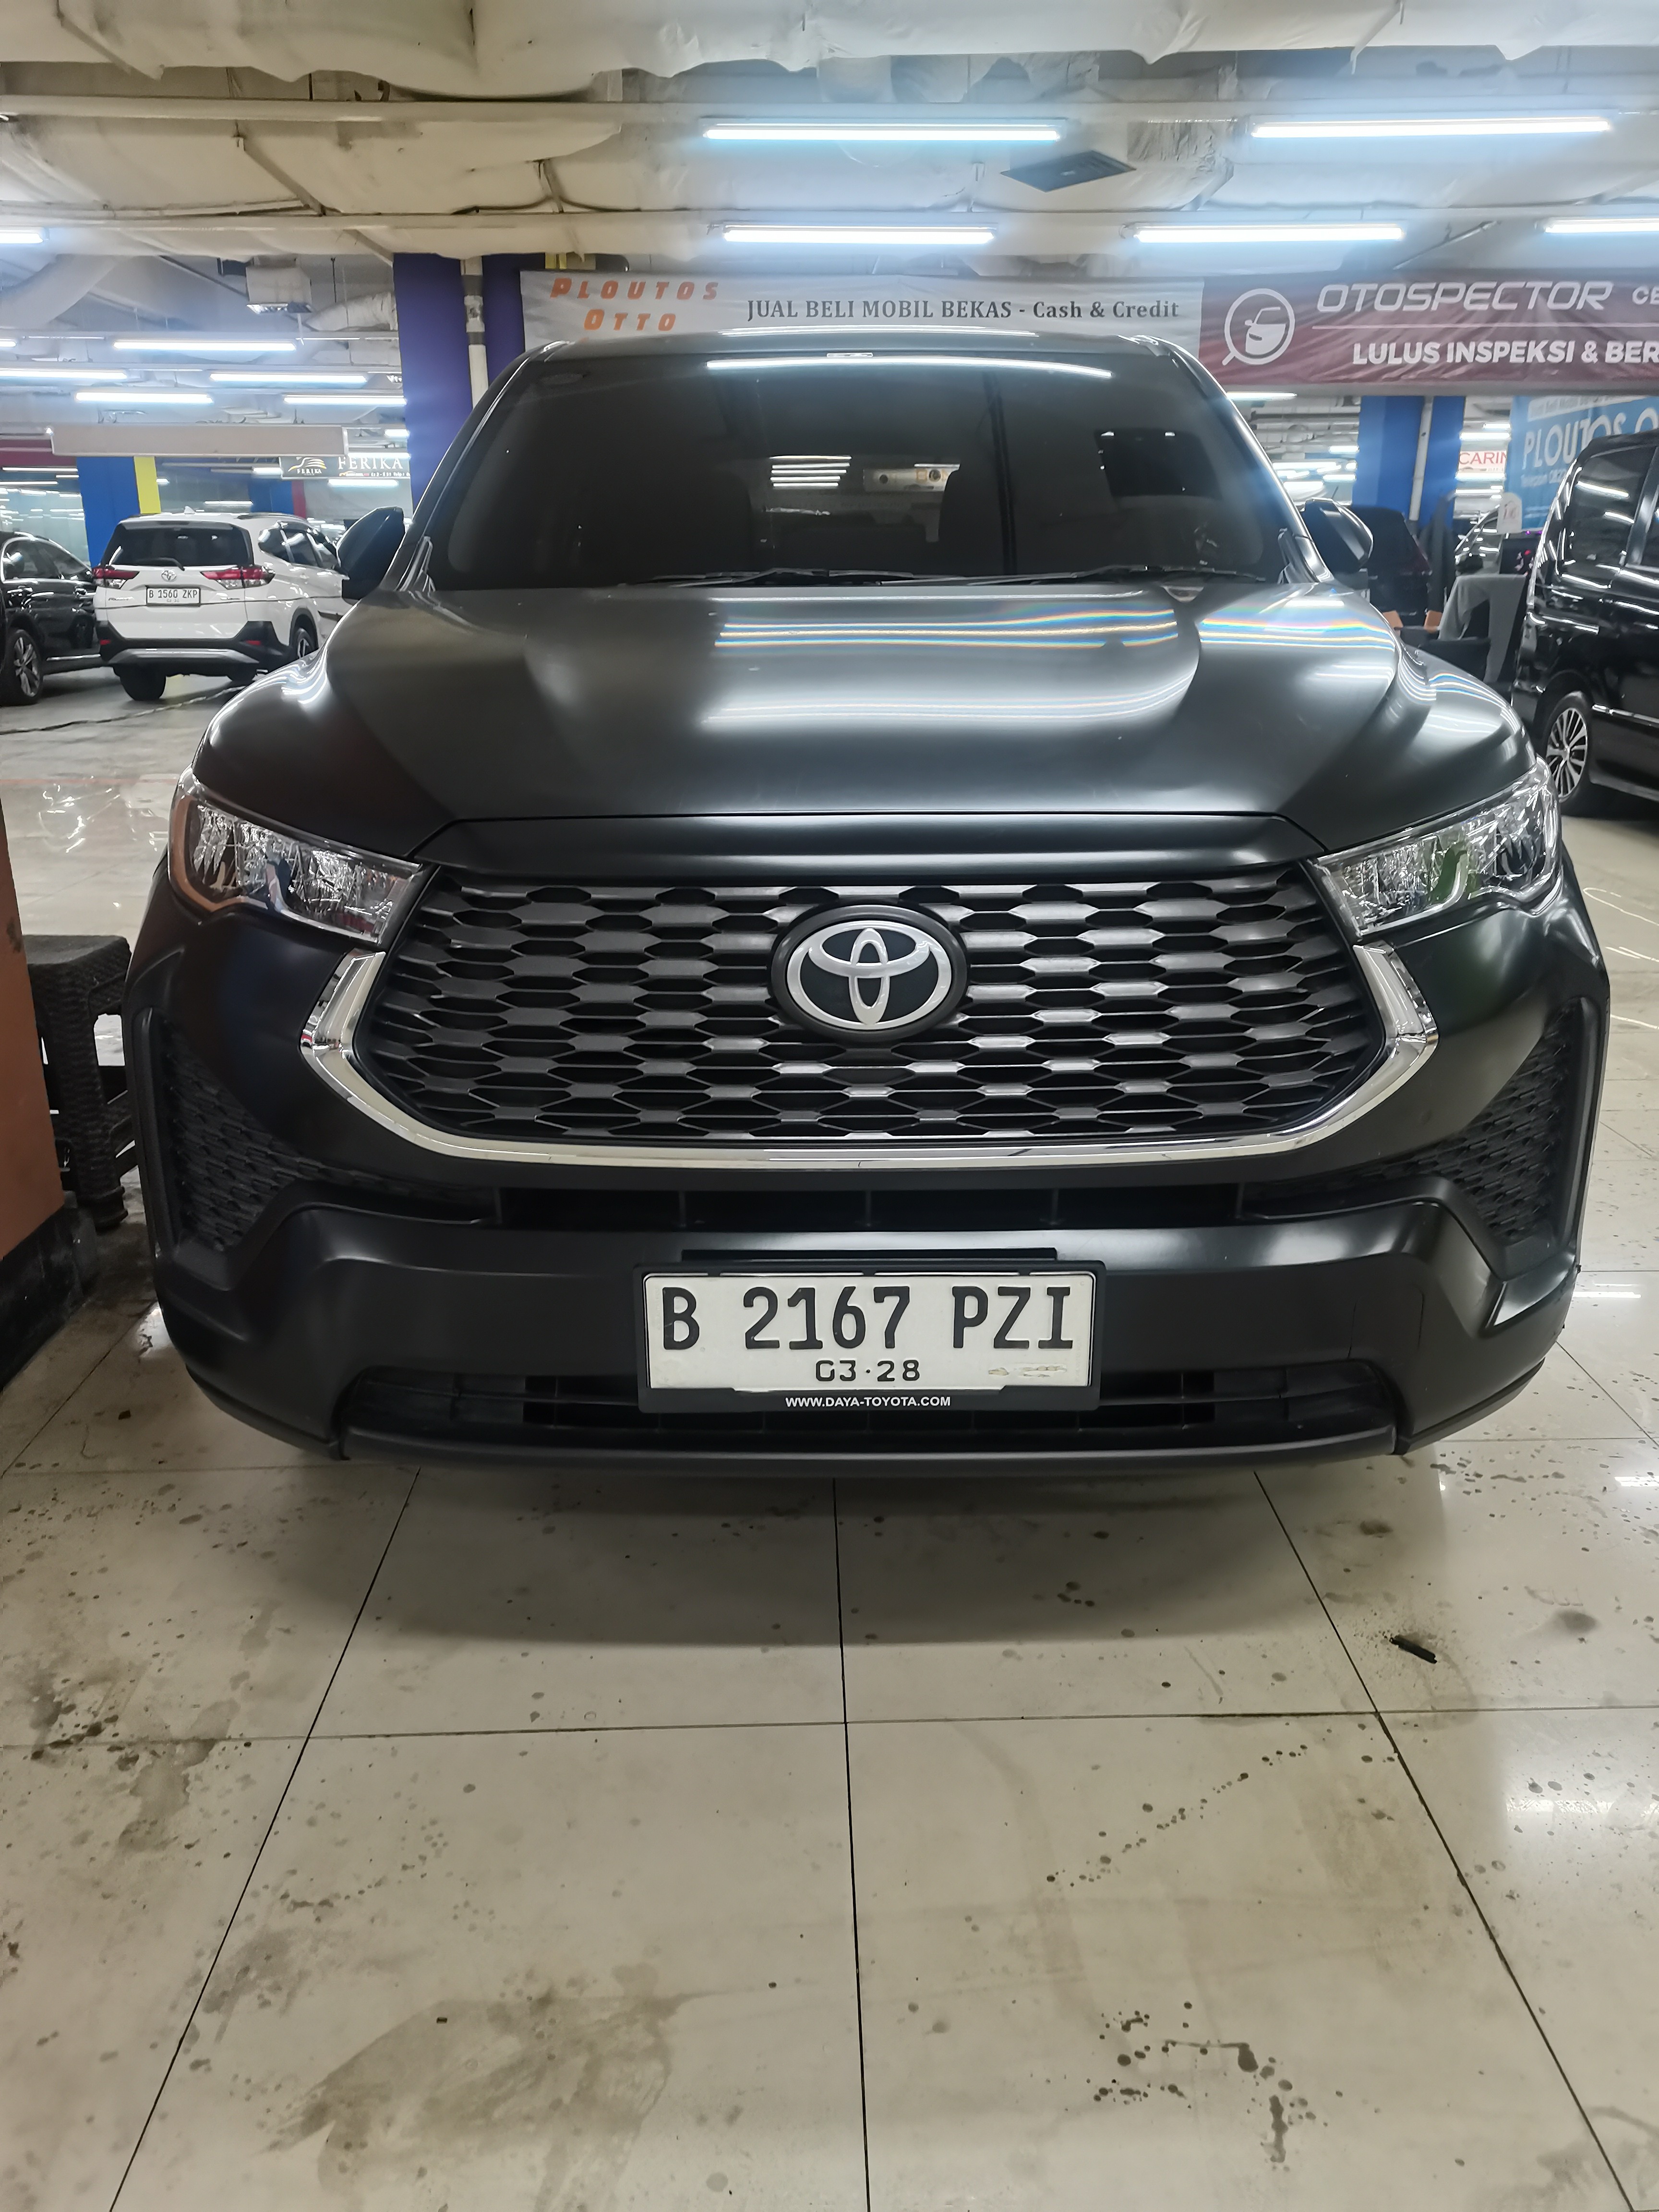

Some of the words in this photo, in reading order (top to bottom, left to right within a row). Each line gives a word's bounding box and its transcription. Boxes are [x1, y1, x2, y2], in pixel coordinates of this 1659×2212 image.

[550, 277, 719, 300] PLOUTOS
[1317, 280, 1614, 312] OTOSPECTOR
[584, 309, 676, 331] OTTO
[747, 300, 798, 322] JUAL
[806, 301, 854, 318] BELI
[863, 300, 934, 318] MOBIL
[941, 301, 1012, 318] BEKAS
[1033, 301, 1082, 318] Cash
[1090, 302, 1106, 318] &
[1113, 301, 1179, 318] Credit
[1353, 342, 1441, 365] LULUS
[1447, 340, 1575, 364] INSPEKSI
[1581, 340, 1599, 364] &
[338, 456, 403, 469] FERIKA
[149, 589, 154, 598] B
[157, 589, 178, 598] 1560
[182, 589, 198, 598] ZKP
[662, 1286, 700, 1350] B
[743, 1286, 910, 1350] 2167
[952, 1286, 1073, 1349] PZI
[785, 1396, 951, 1408] WWW.DAYA-TOYOTA.COM
